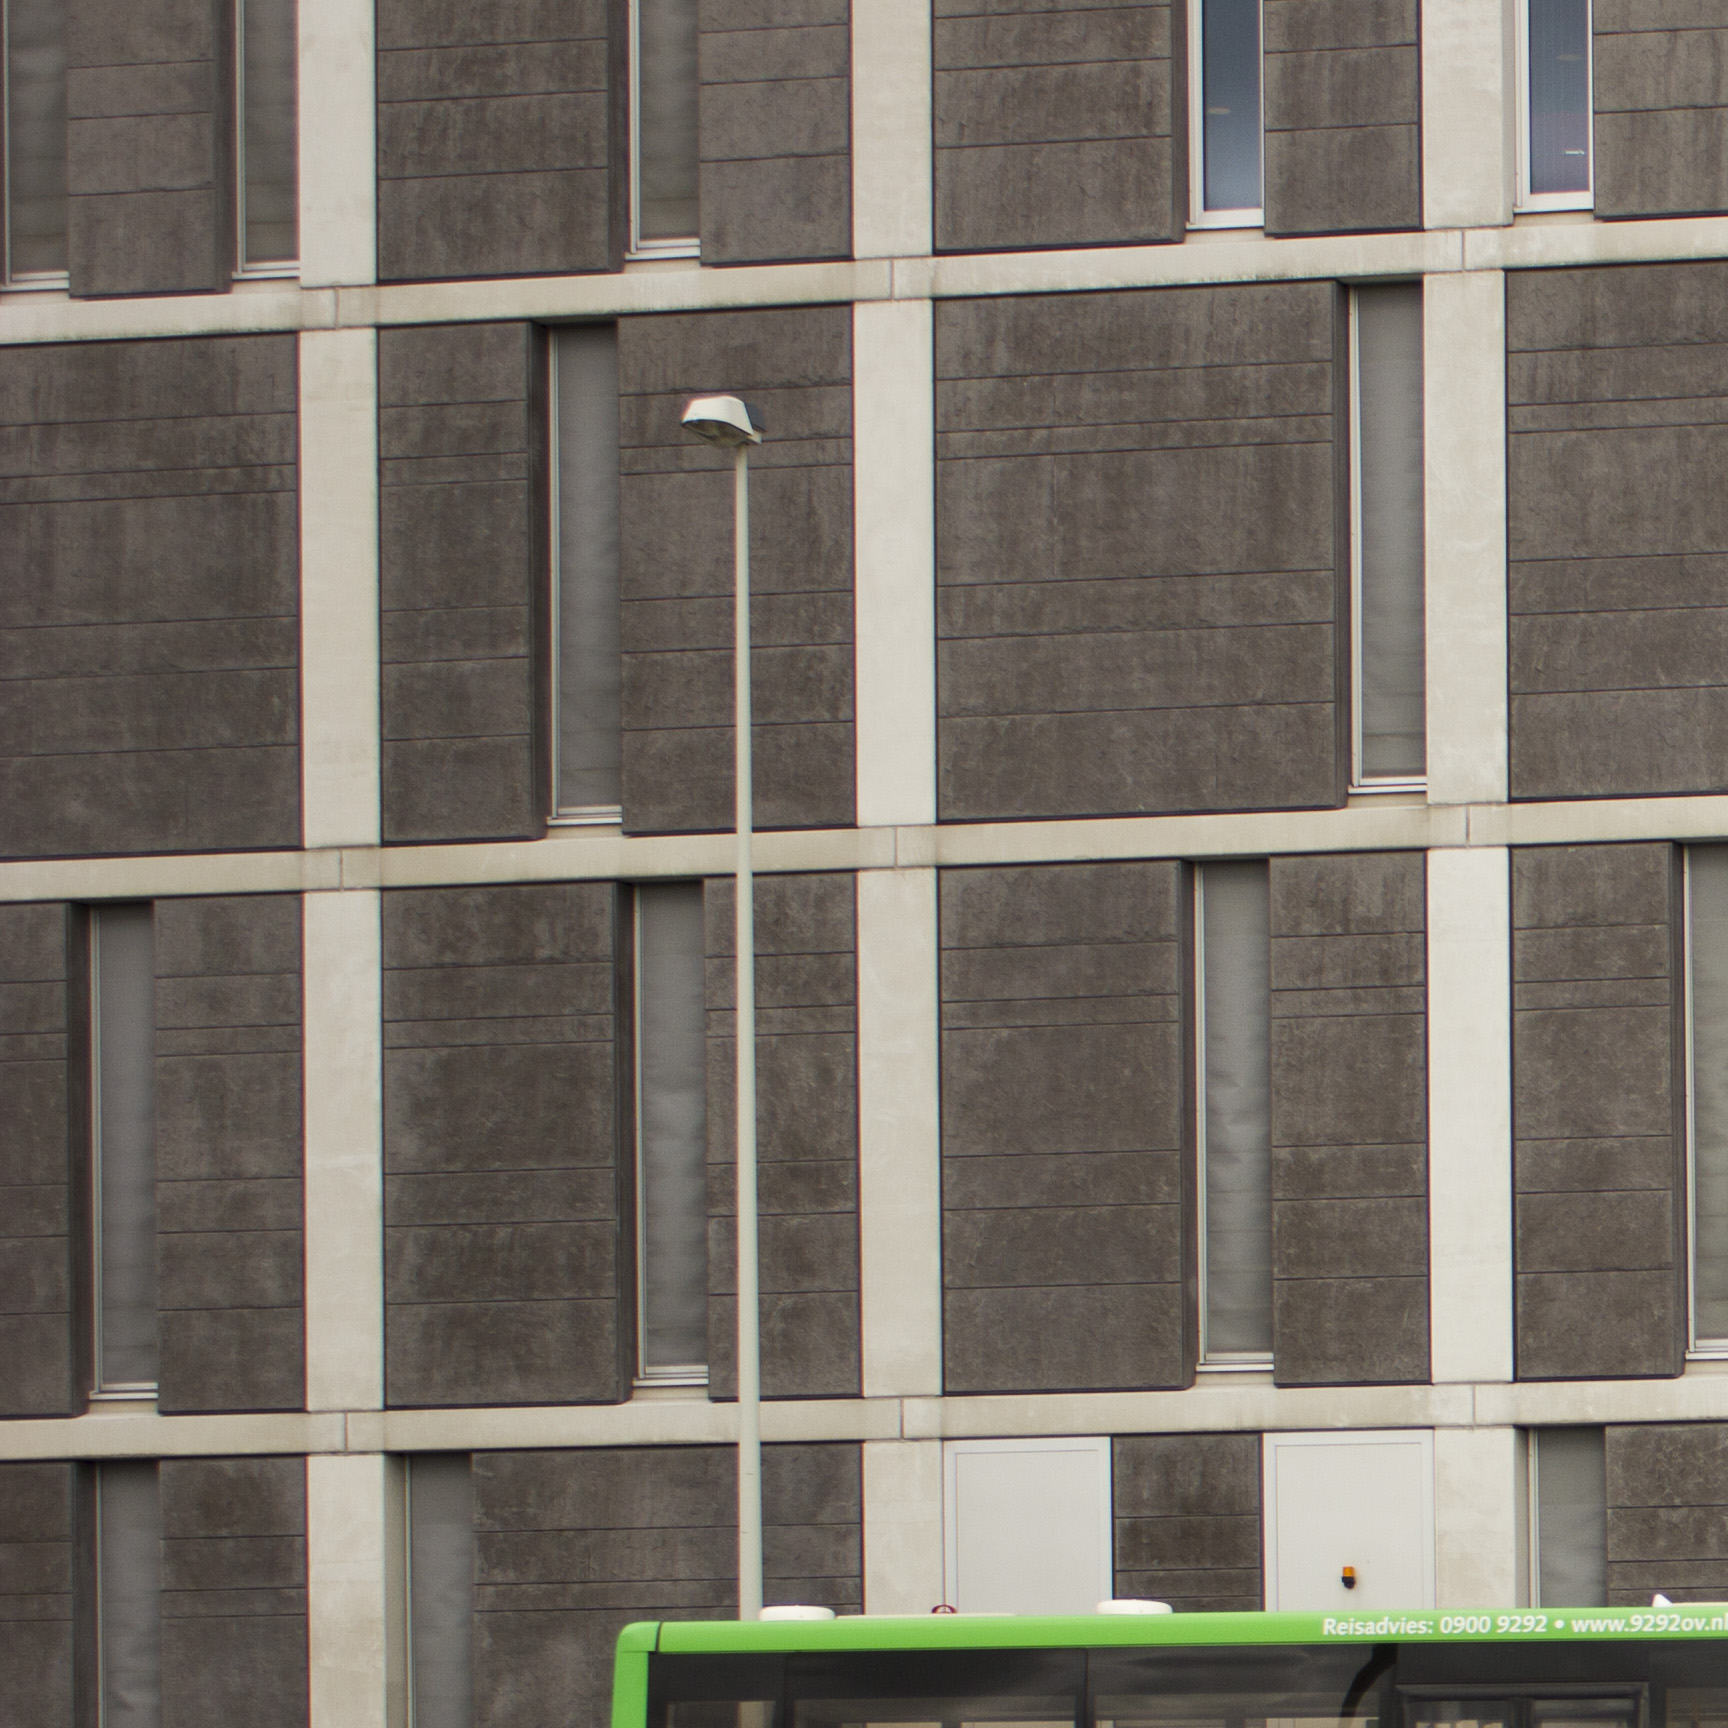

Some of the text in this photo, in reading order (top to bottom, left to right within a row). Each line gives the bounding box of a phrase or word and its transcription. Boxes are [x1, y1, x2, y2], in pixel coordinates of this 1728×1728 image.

[1322, 1617, 1433, 1635] Reisadvies:
[1439, 1617, 1491, 1634] 0900
[1496, 1615, 1548, 1633] 9292
